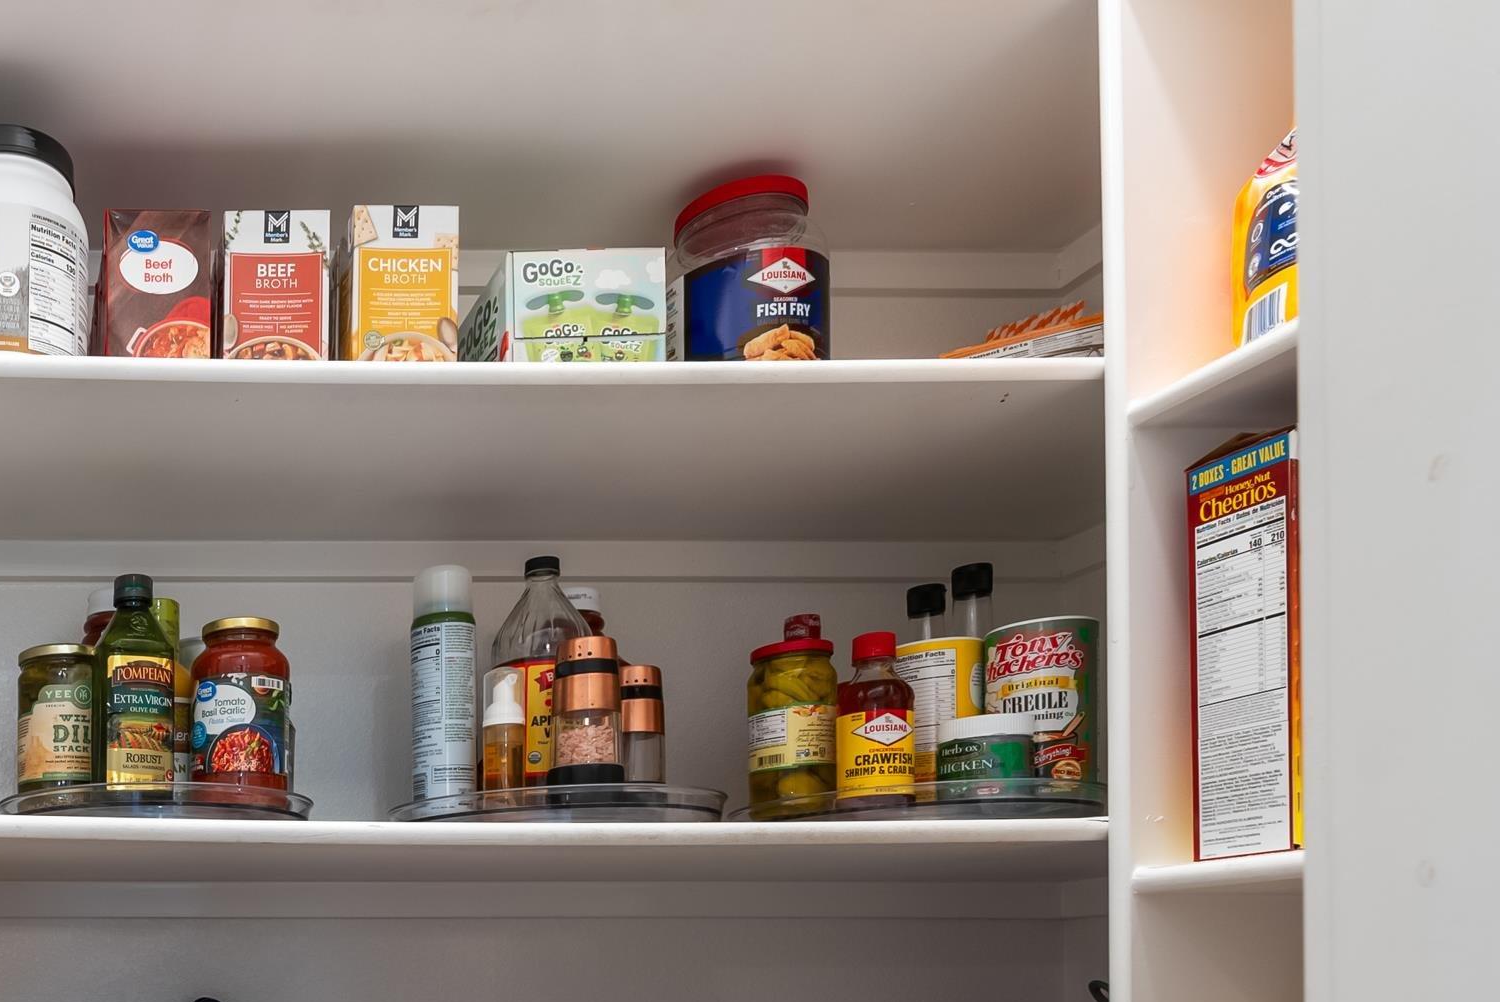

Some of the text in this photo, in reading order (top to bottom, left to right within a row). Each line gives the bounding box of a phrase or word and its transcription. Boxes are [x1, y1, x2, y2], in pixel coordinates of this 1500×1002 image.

[31, 223, 61, 241] Nutrition
[131, 235, 155, 246] Great
[31, 251, 55, 264] Calories
[145, 258, 173, 270] Beef
[257, 263, 296, 278] BEEF
[368, 257, 442, 273] CHICKEN
[522, 259, 575, 284] GoGo
[144, 272, 173, 283] Broth
[384, 274, 427, 284] BROTH
[538, 275, 581, 287] SQUEEZ
[761, 270, 807, 282] LOUISIANA
[255, 278, 298, 289] BROTH
[756, 302, 811, 318] FISH FRY
[611, 342, 641, 352] SQUEEZ
[1192, 440, 1285, 490] 2 BOXES GREAT VALUE
[1225, 471, 1271, 495] Honey Nut
[1199, 481, 1277, 522] Cheerios
[1271, 530, 1285, 542] 210
[1249, 537, 1262, 549] 140
[423, 625, 441, 633] Facts
[996, 631, 1072, 661] Tony
[116, 667, 172, 684] POMPEIAN
[1007, 678, 1060, 692] Original
[45, 690, 72, 699] YEE
[114, 693, 172, 707] EXTRA VIRGIN
[214, 698, 246, 707] Tomato
[1002, 690, 1069, 714] CREOLE
[130, 706, 148, 714] OLIVE
[201, 706, 246, 719] Basil Garlic
[864, 723, 908, 735] LOUISIANA
[125, 753, 163, 764] ROBUST
[854, 753, 913, 767] CRAWFISH
[1033, 746, 1073, 763] Everything!
[845, 765, 907, 779] SHRIMP & CRAB
